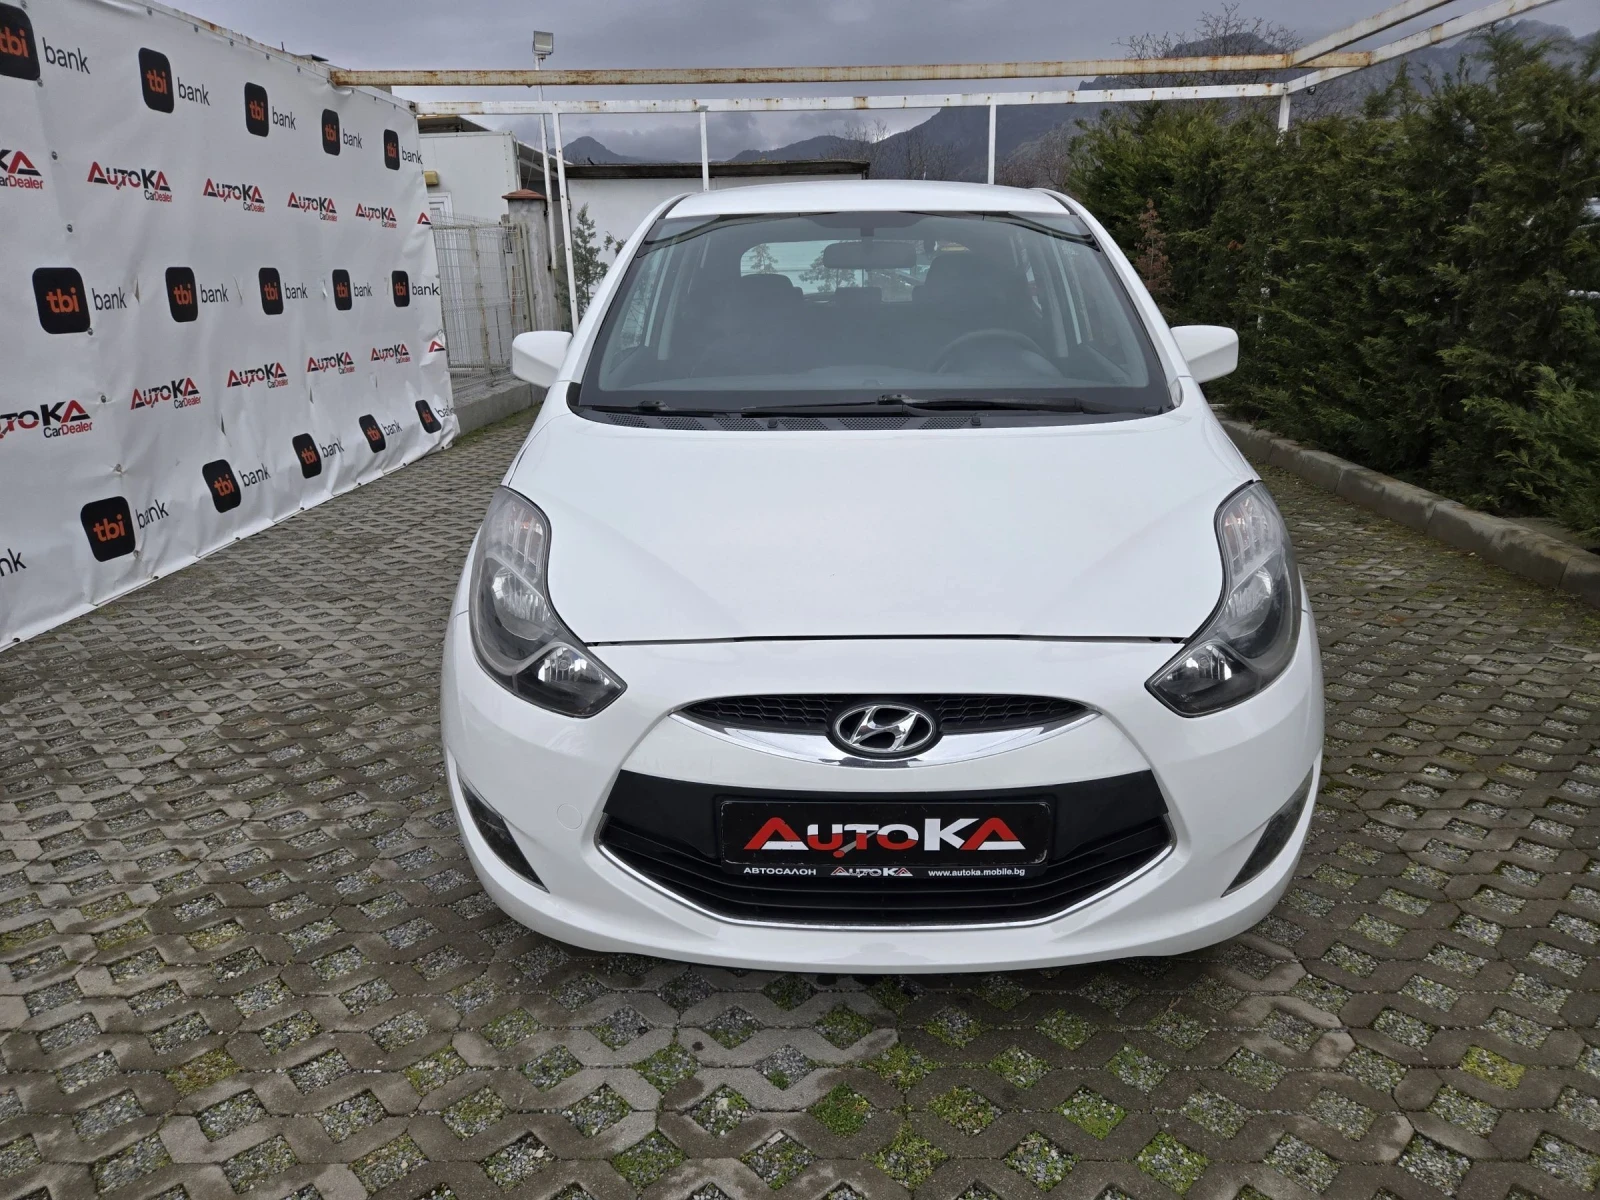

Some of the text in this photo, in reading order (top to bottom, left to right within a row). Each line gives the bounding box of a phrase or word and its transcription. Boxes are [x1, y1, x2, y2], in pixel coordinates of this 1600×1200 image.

[0, 26, 91, 75] tbi bank
[146, 69, 211, 106] tbi bank
[249, 100, 297, 131] tbi bank
[324, 124, 363, 150] tbi bank
[401, 147, 424, 165] bank
[0, 175, 44, 189] arDealer
[144, 189, 173, 202] CarDealer
[46, 286, 128, 313] tbi bank
[173, 283, 230, 305] tbi bank
[263, 282, 309, 301] tbi bank
[336, 282, 373, 298] tbi bank
[411, 282, 441, 297] bank
[174, 396, 202, 409] CarDealer
[0, 399, 91, 435] TOKA
[43, 421, 93, 439] CarDealer
[381, 420, 403, 437] bank
[301, 437, 345, 465] tbi bank
[213, 463, 272, 497] tbi bank
[93, 499, 169, 542] tbi bank
[0, 548, 27, 577] nk
[743, 867, 817, 876] АВТОСАЛОН
[928, 867, 1026, 877] www.autoka.mobile.bg
